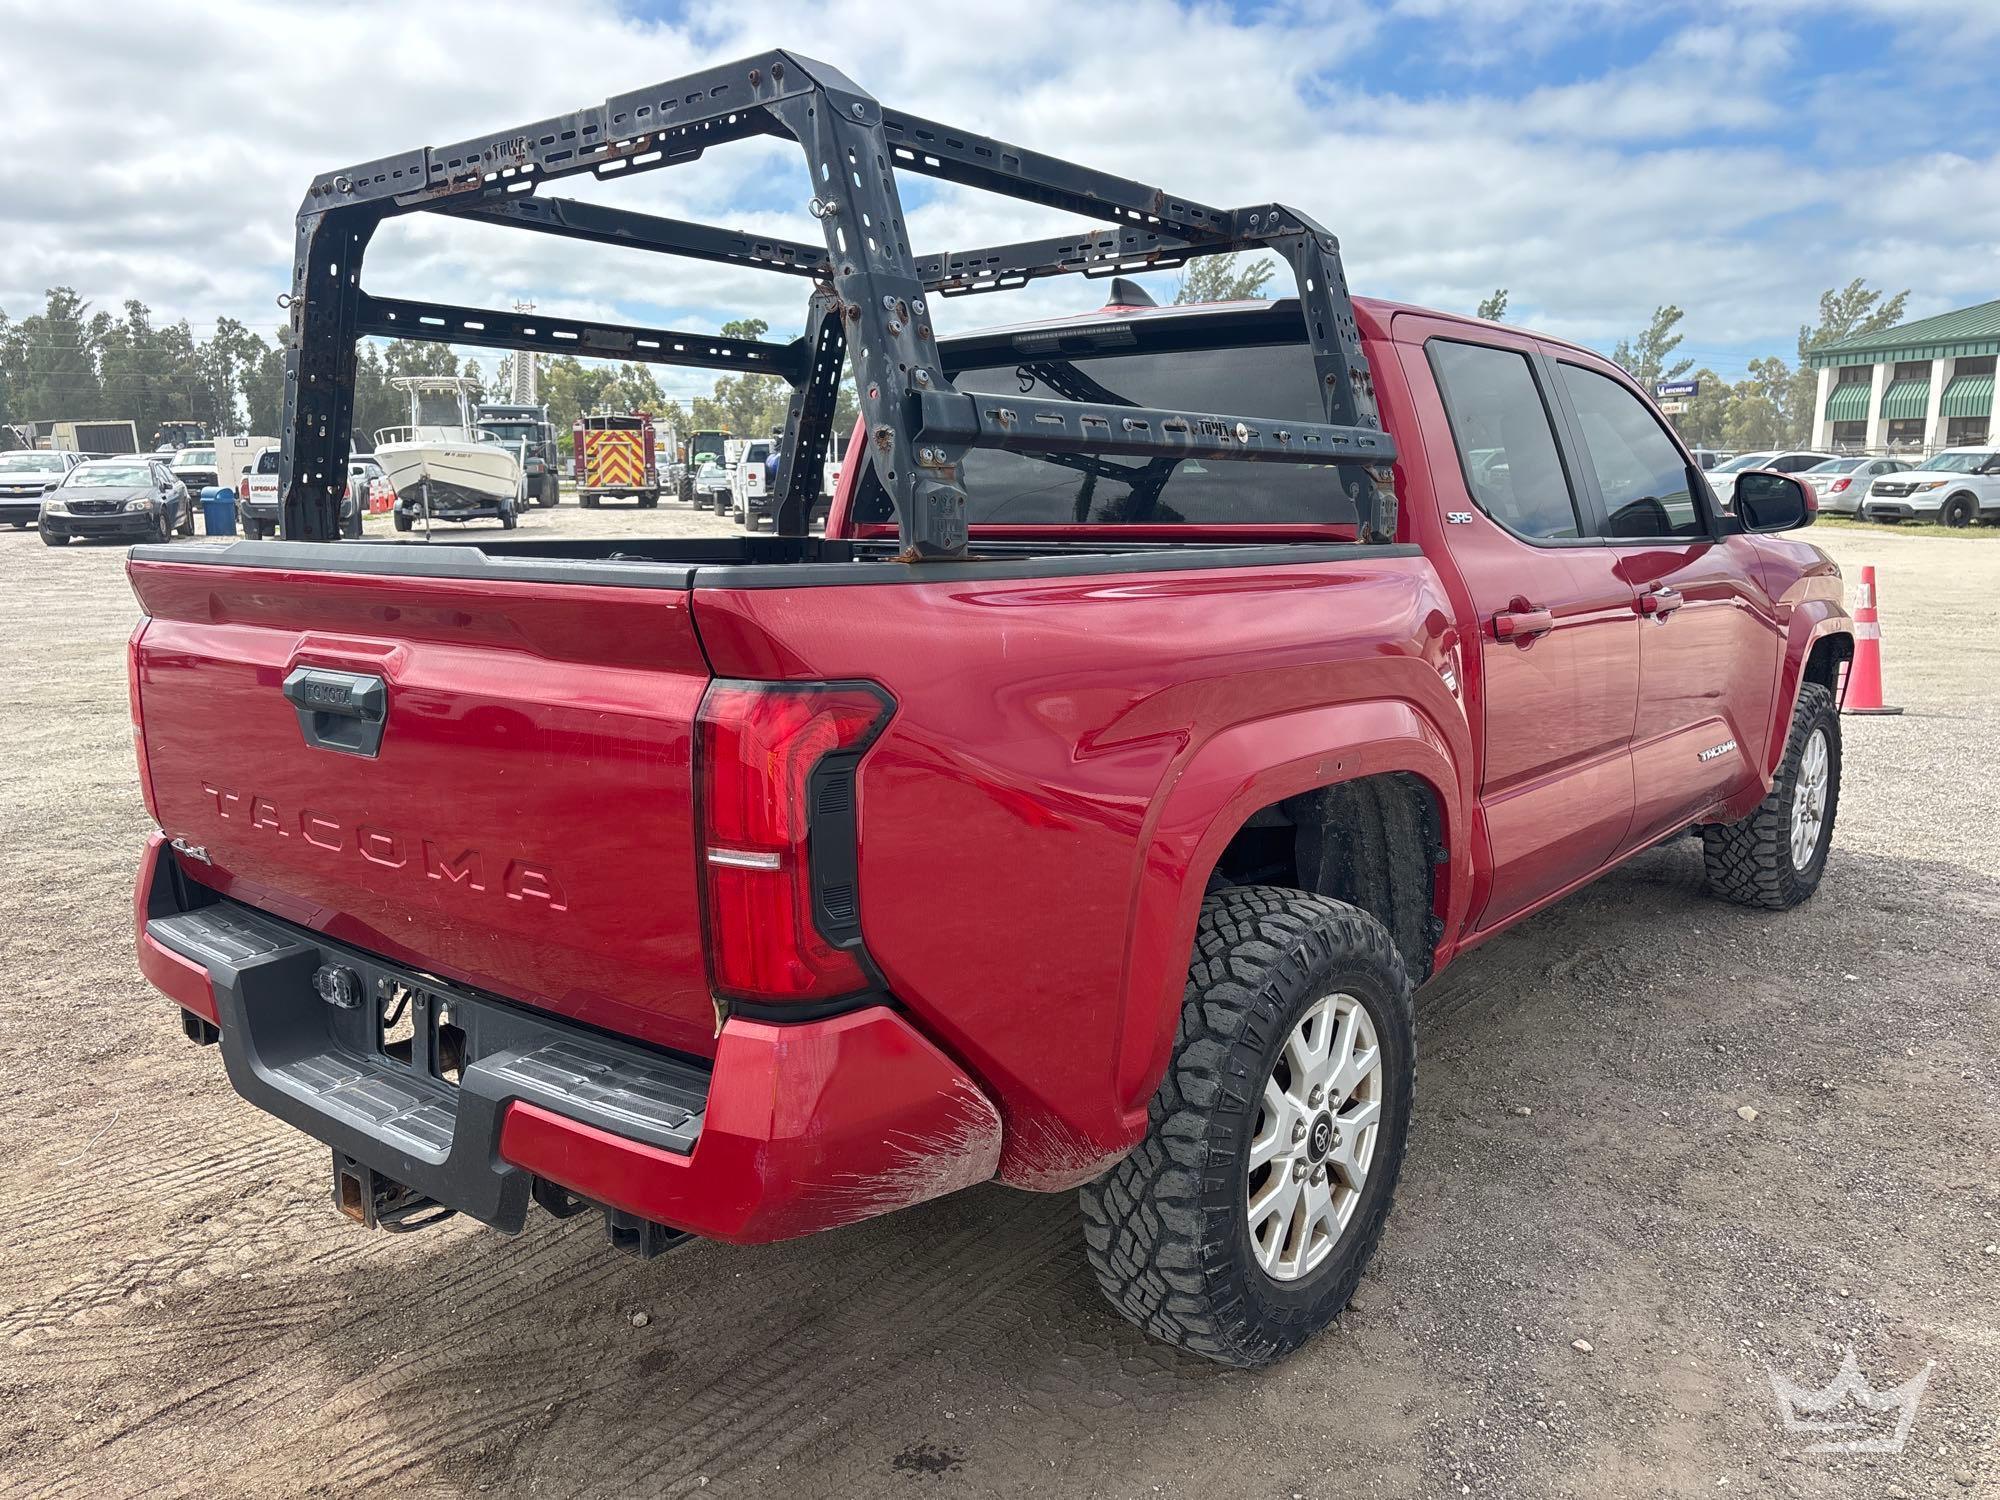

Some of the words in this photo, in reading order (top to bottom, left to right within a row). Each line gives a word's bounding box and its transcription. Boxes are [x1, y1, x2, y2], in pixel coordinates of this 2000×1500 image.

[1446, 511, 1473, 524] SR5
[306, 683, 353, 706] TOYOTA
[1697, 739, 1737, 762] TACOMA
[201, 779, 568, 911] TACOMA
